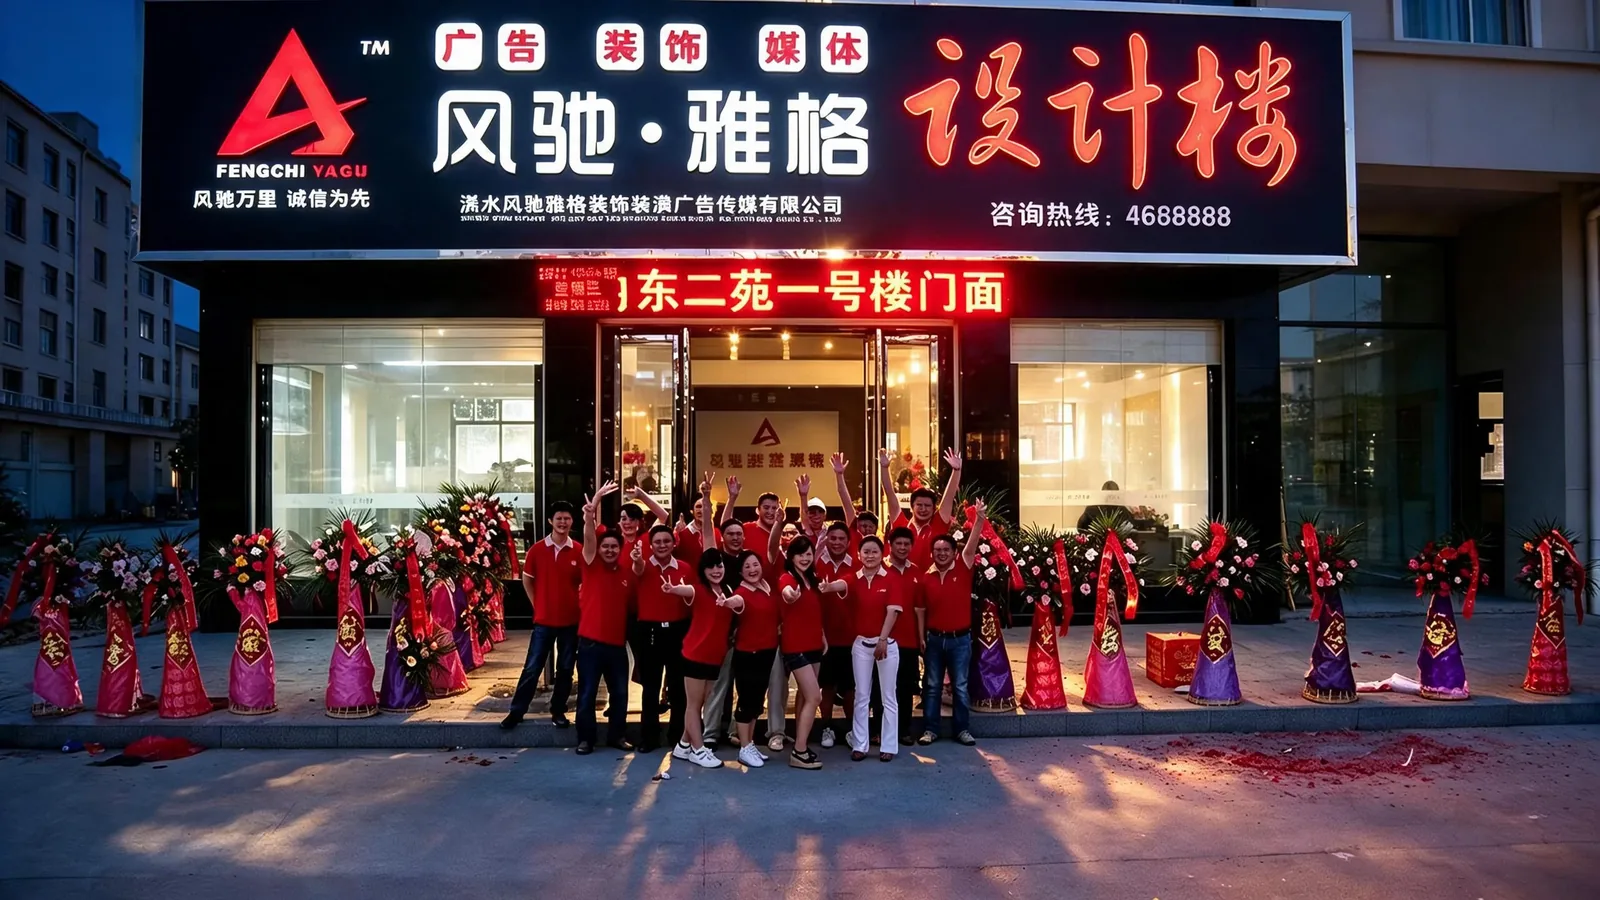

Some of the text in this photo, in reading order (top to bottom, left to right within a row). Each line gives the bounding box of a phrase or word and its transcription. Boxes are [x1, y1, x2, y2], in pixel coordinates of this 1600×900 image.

[360, 40, 390, 56] TM
[440, 27, 865, 68] 广告 装饰 媒体
[903, 33, 1297, 189] 设计楼
[216, 164, 305, 178] FENGCHI
[193, 188, 370, 209] 风驰万里 诚信为先
